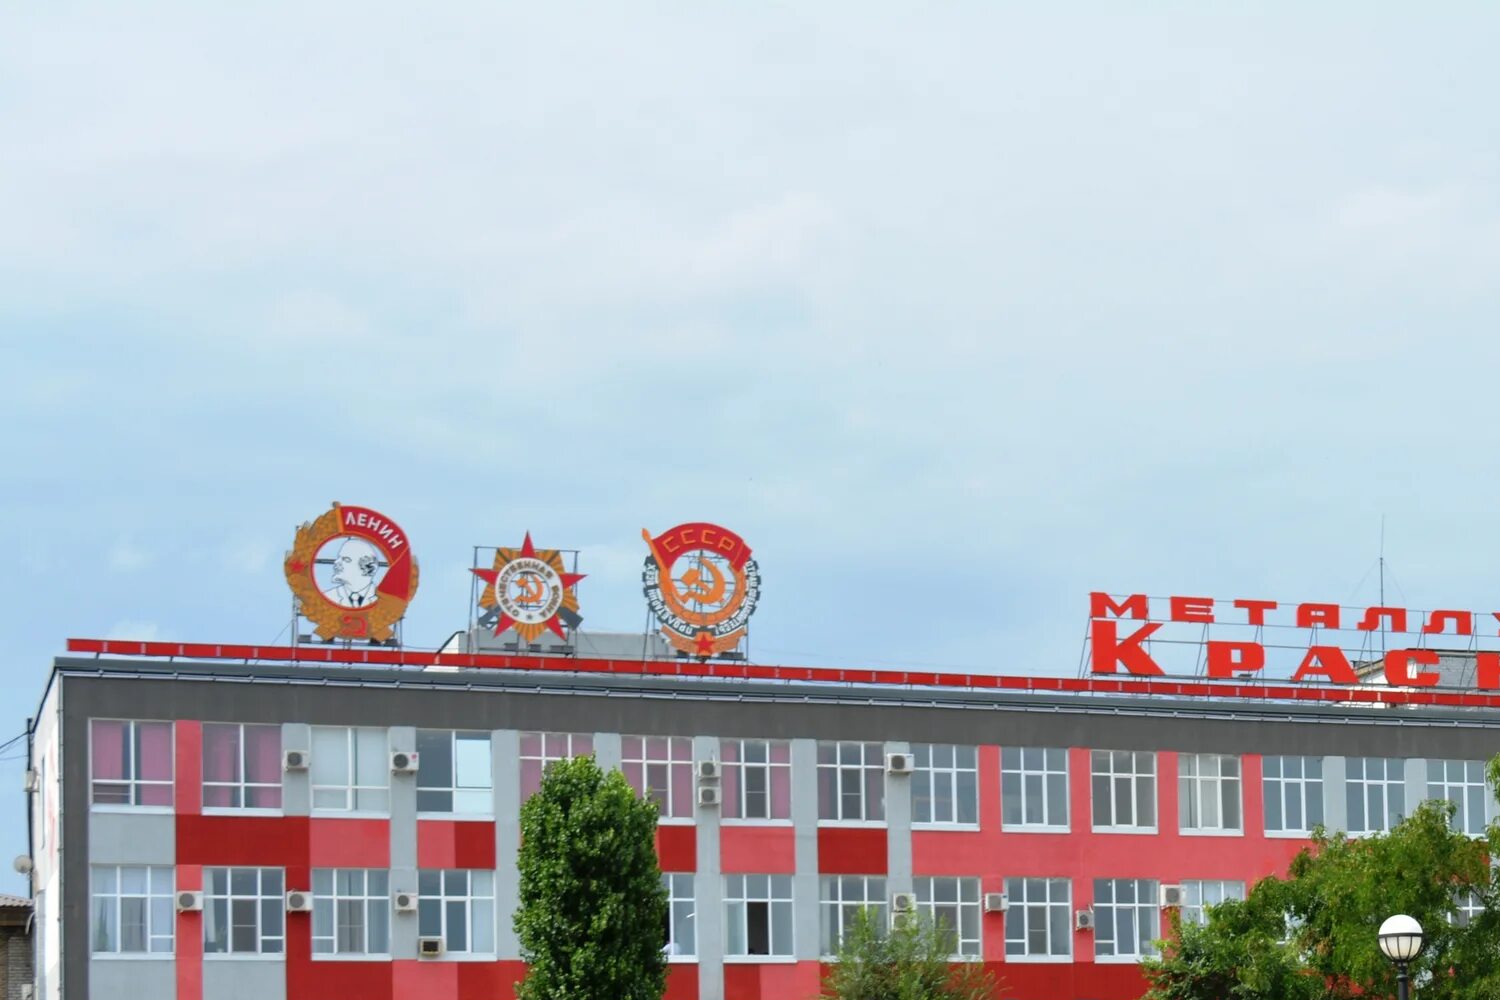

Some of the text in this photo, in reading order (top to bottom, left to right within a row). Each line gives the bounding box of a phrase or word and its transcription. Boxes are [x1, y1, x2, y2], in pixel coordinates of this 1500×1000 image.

[345, 511, 404, 549] ЛЕНИН
[662, 529, 736, 553] СССР
[645, 563, 657, 586] ВСЕХ
